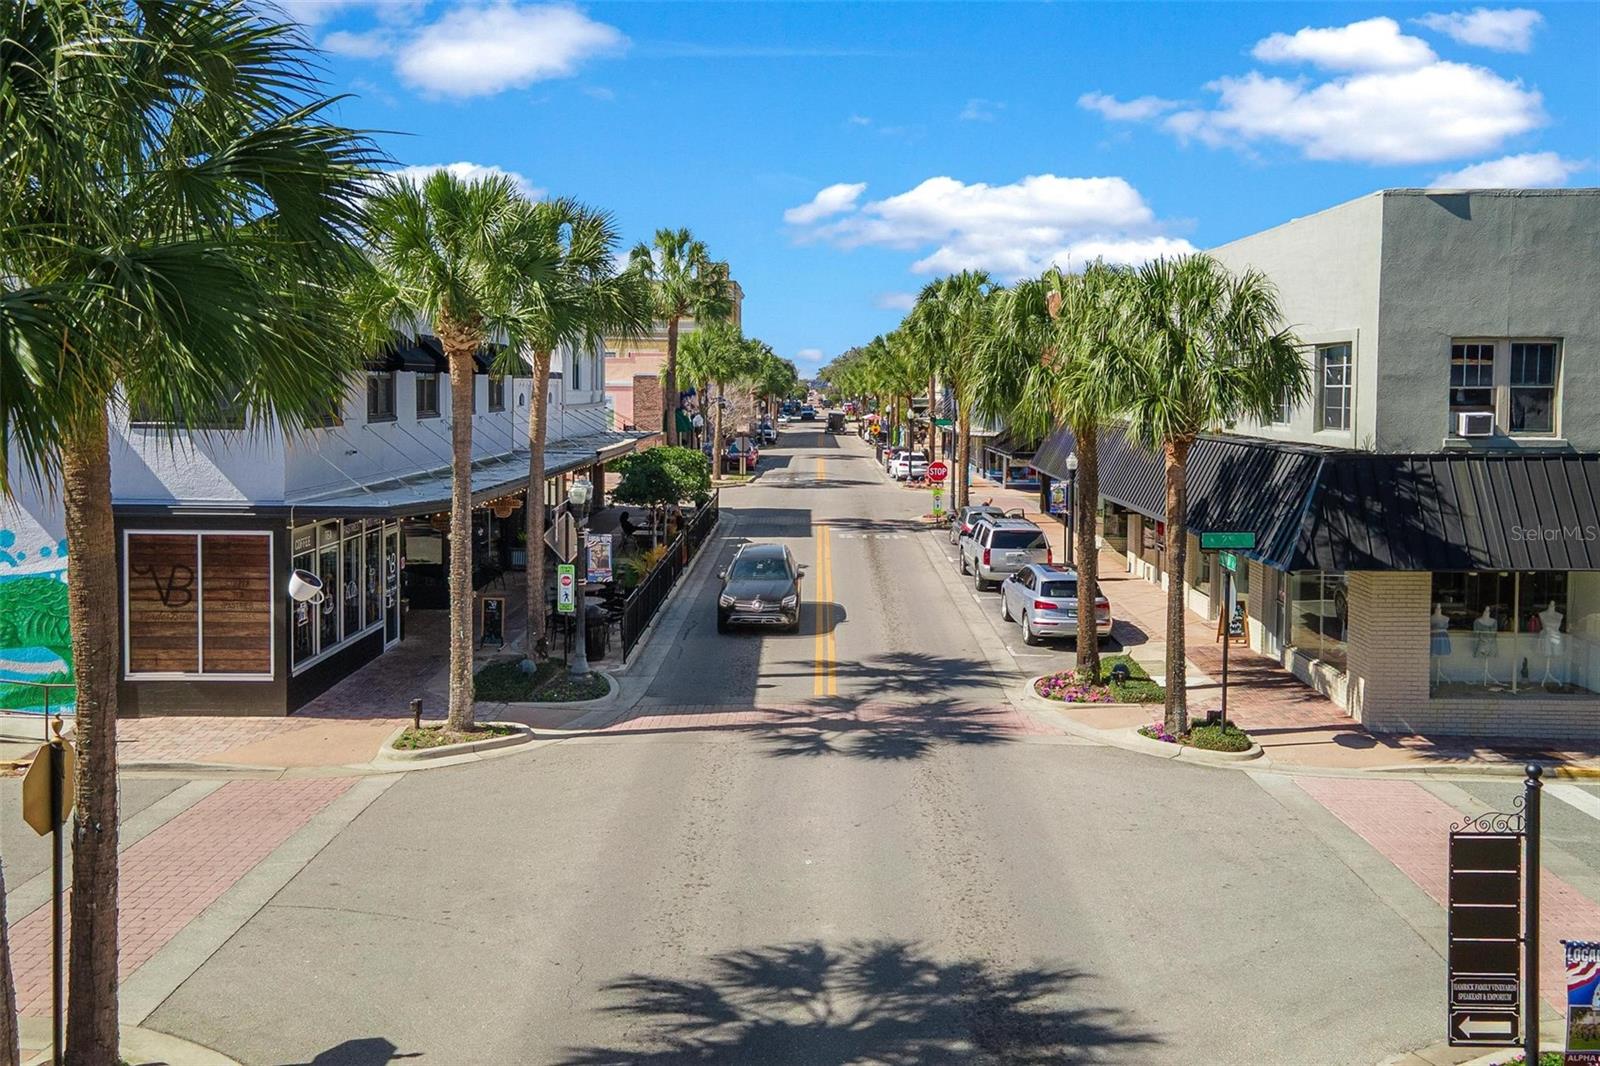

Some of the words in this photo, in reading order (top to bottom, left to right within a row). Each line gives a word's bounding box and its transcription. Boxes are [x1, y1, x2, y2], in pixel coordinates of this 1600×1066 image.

[929, 467, 946, 476] STOP
[294, 535, 311, 551] COFFEE
[1475, 983, 1491, 991] FAMILY
[1491, 983, 1517, 992] VINEYARDS
[1458, 992, 1482, 1001] SPEAKEASY
[1487, 993, 1512, 1001] EMPORIUM
[1567, 1054, 1597, 1062] ALPHA
